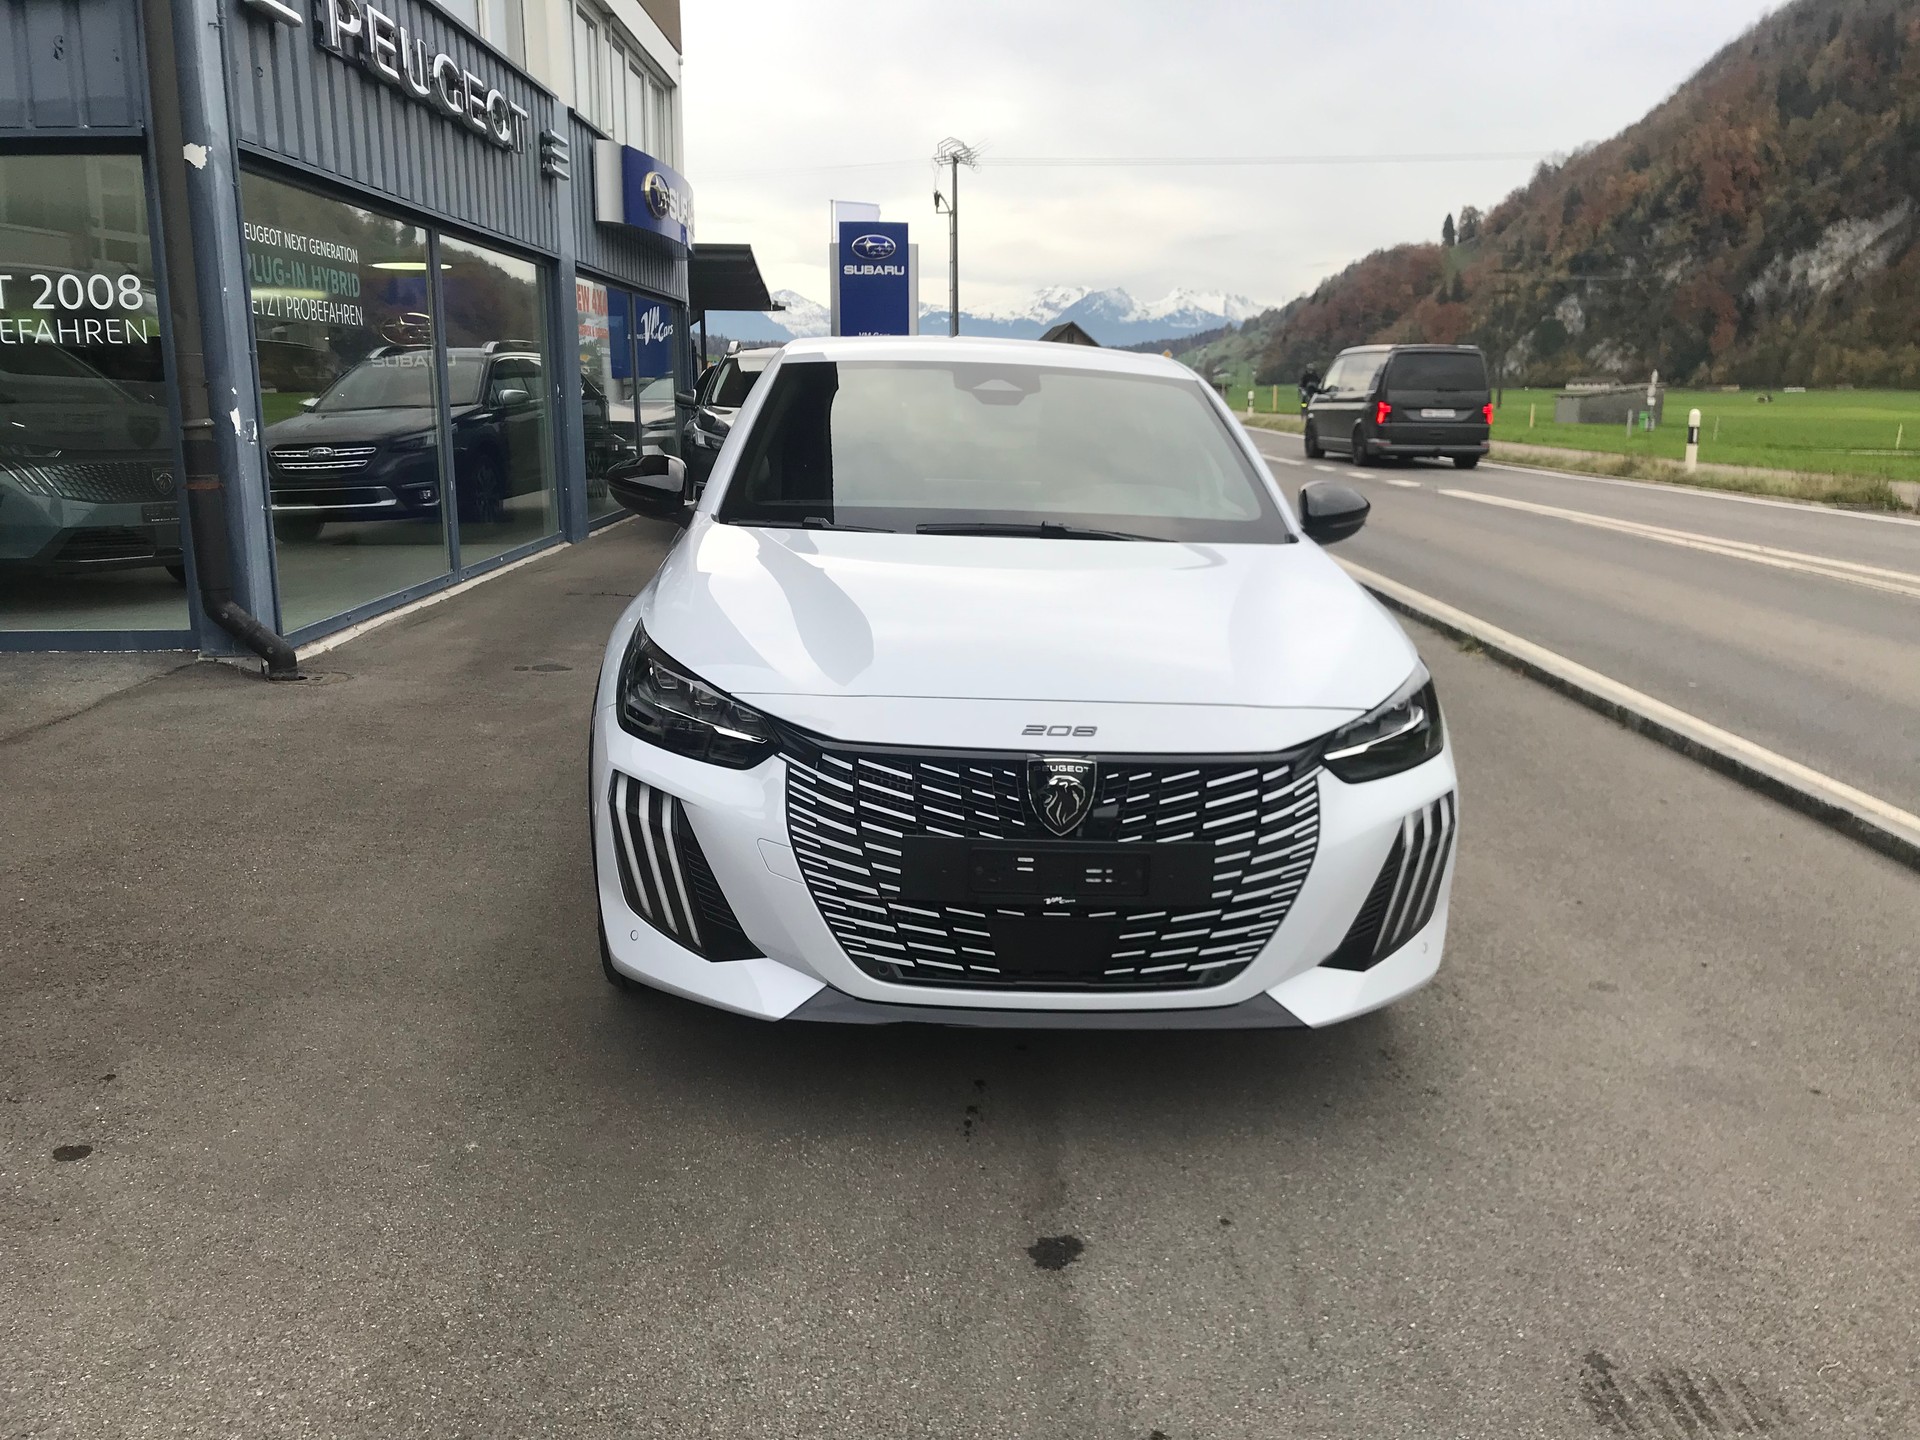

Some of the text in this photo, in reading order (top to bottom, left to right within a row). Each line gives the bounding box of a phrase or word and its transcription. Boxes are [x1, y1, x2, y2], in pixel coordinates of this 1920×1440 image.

[320, 0, 528, 154] PEUGEOT
[243, 222, 359, 264] EUGEOT NEXT GENERATION
[311, 264, 360, 297] HYBRID
[843, 264, 905, 275] SUBARU
[30, 273, 144, 310] 2008
[251, 294, 364, 326] ETZT PROBEFAHREN
[658, 322, 674, 342] Cars
[371, 355, 457, 368] SUBAU
[1021, 724, 1098, 737] 208
